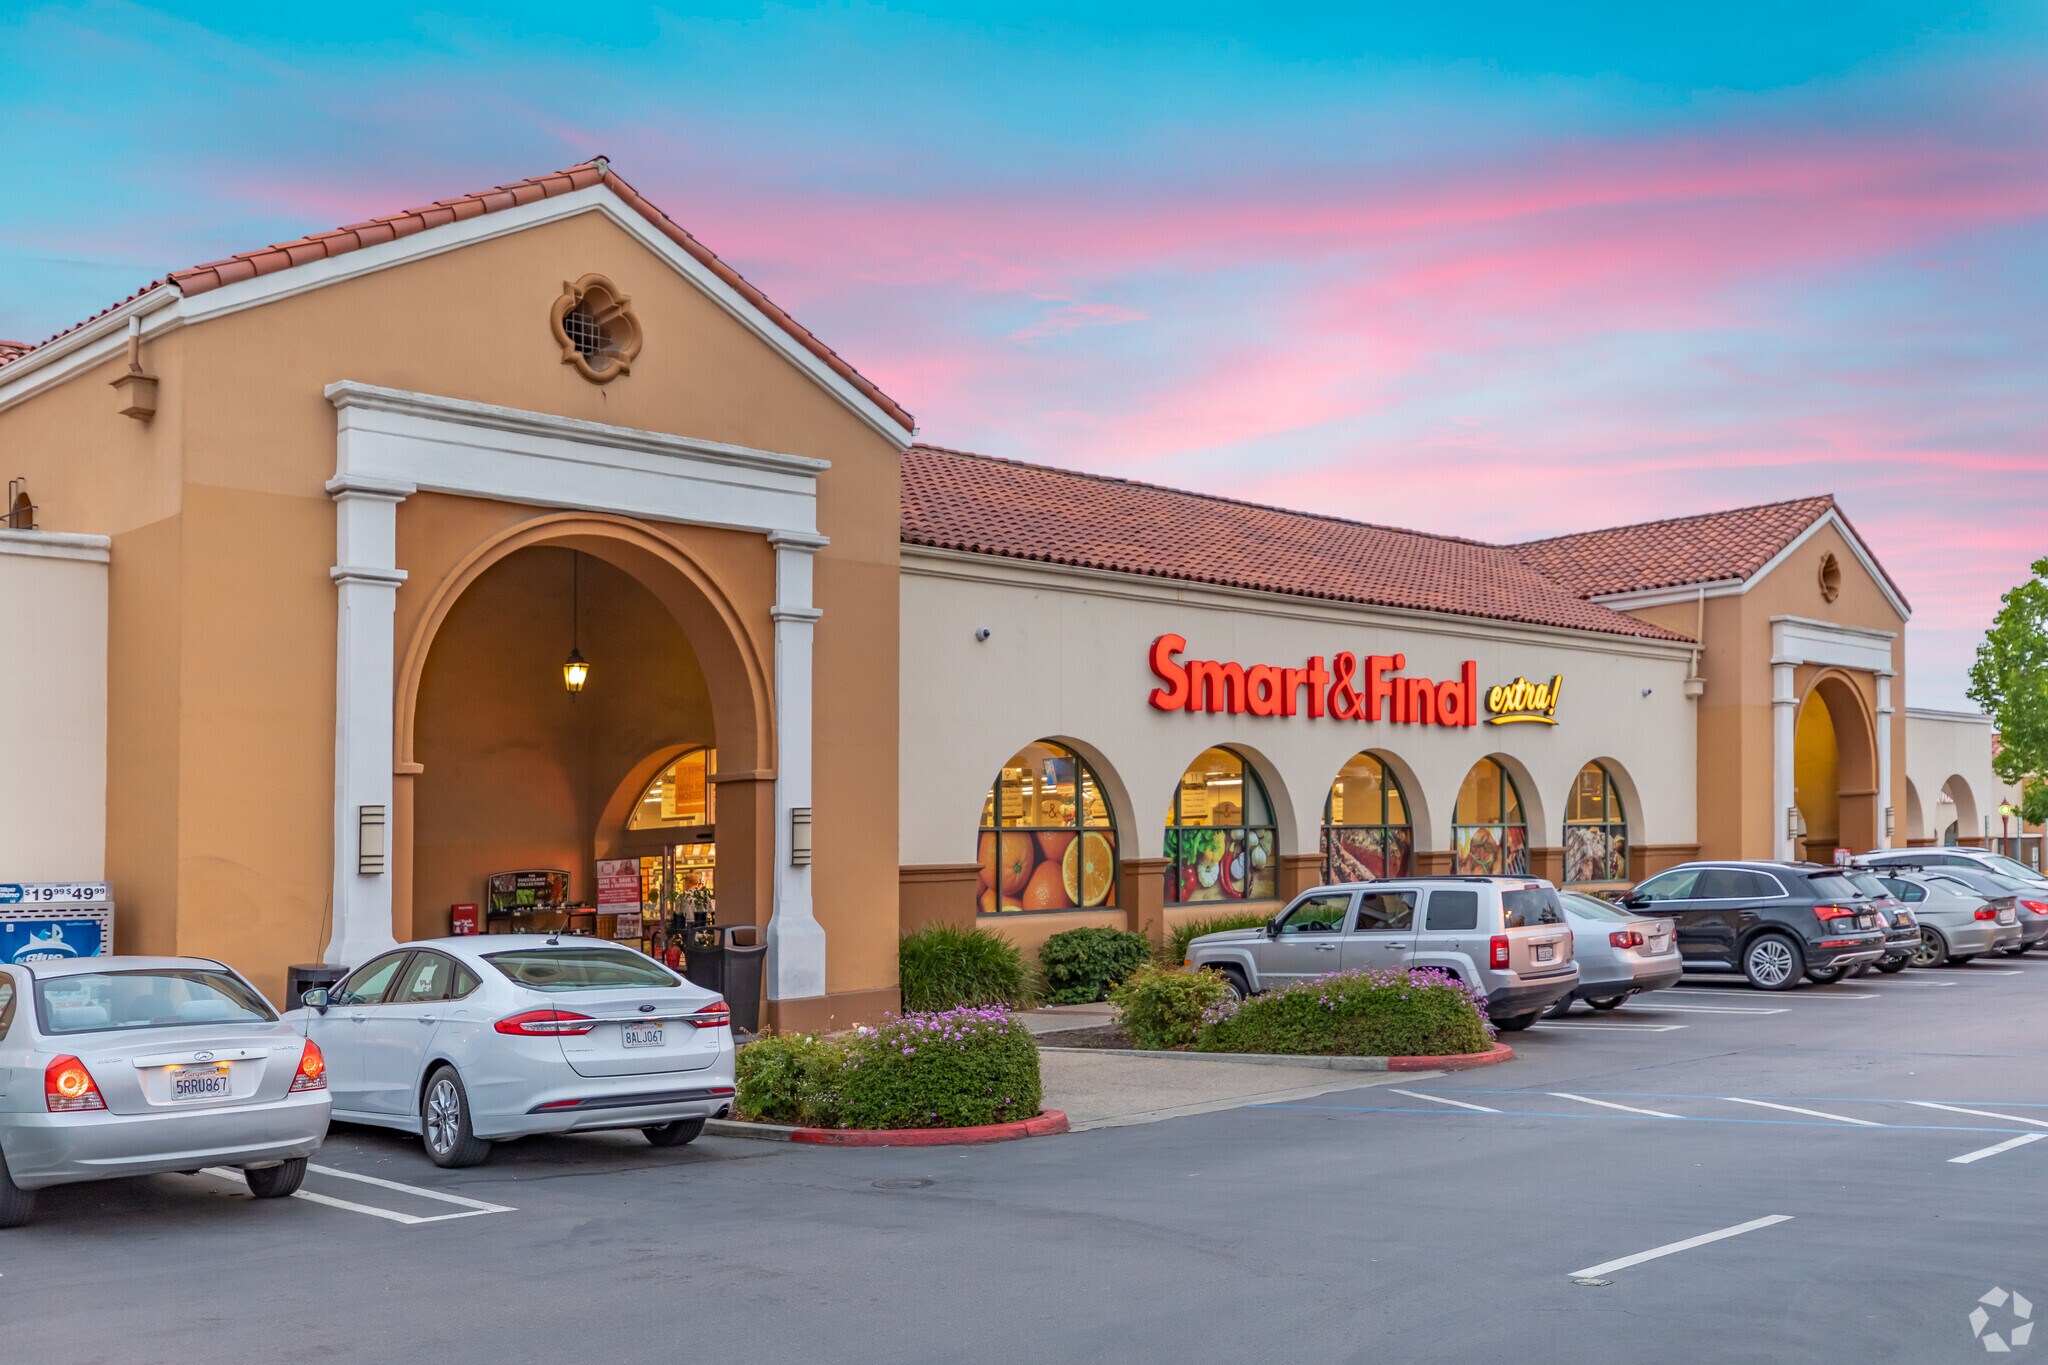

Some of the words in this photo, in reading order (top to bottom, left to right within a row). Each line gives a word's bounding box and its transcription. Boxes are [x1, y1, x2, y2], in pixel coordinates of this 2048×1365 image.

[1485, 674, 1563, 716] extra!
[1004, 770, 1011, 778] 9
[1191, 773, 1198, 782] 11
[625, 1030, 663, 1043] 8ALJ067
[176, 1077, 227, 1094] 5RRU867
